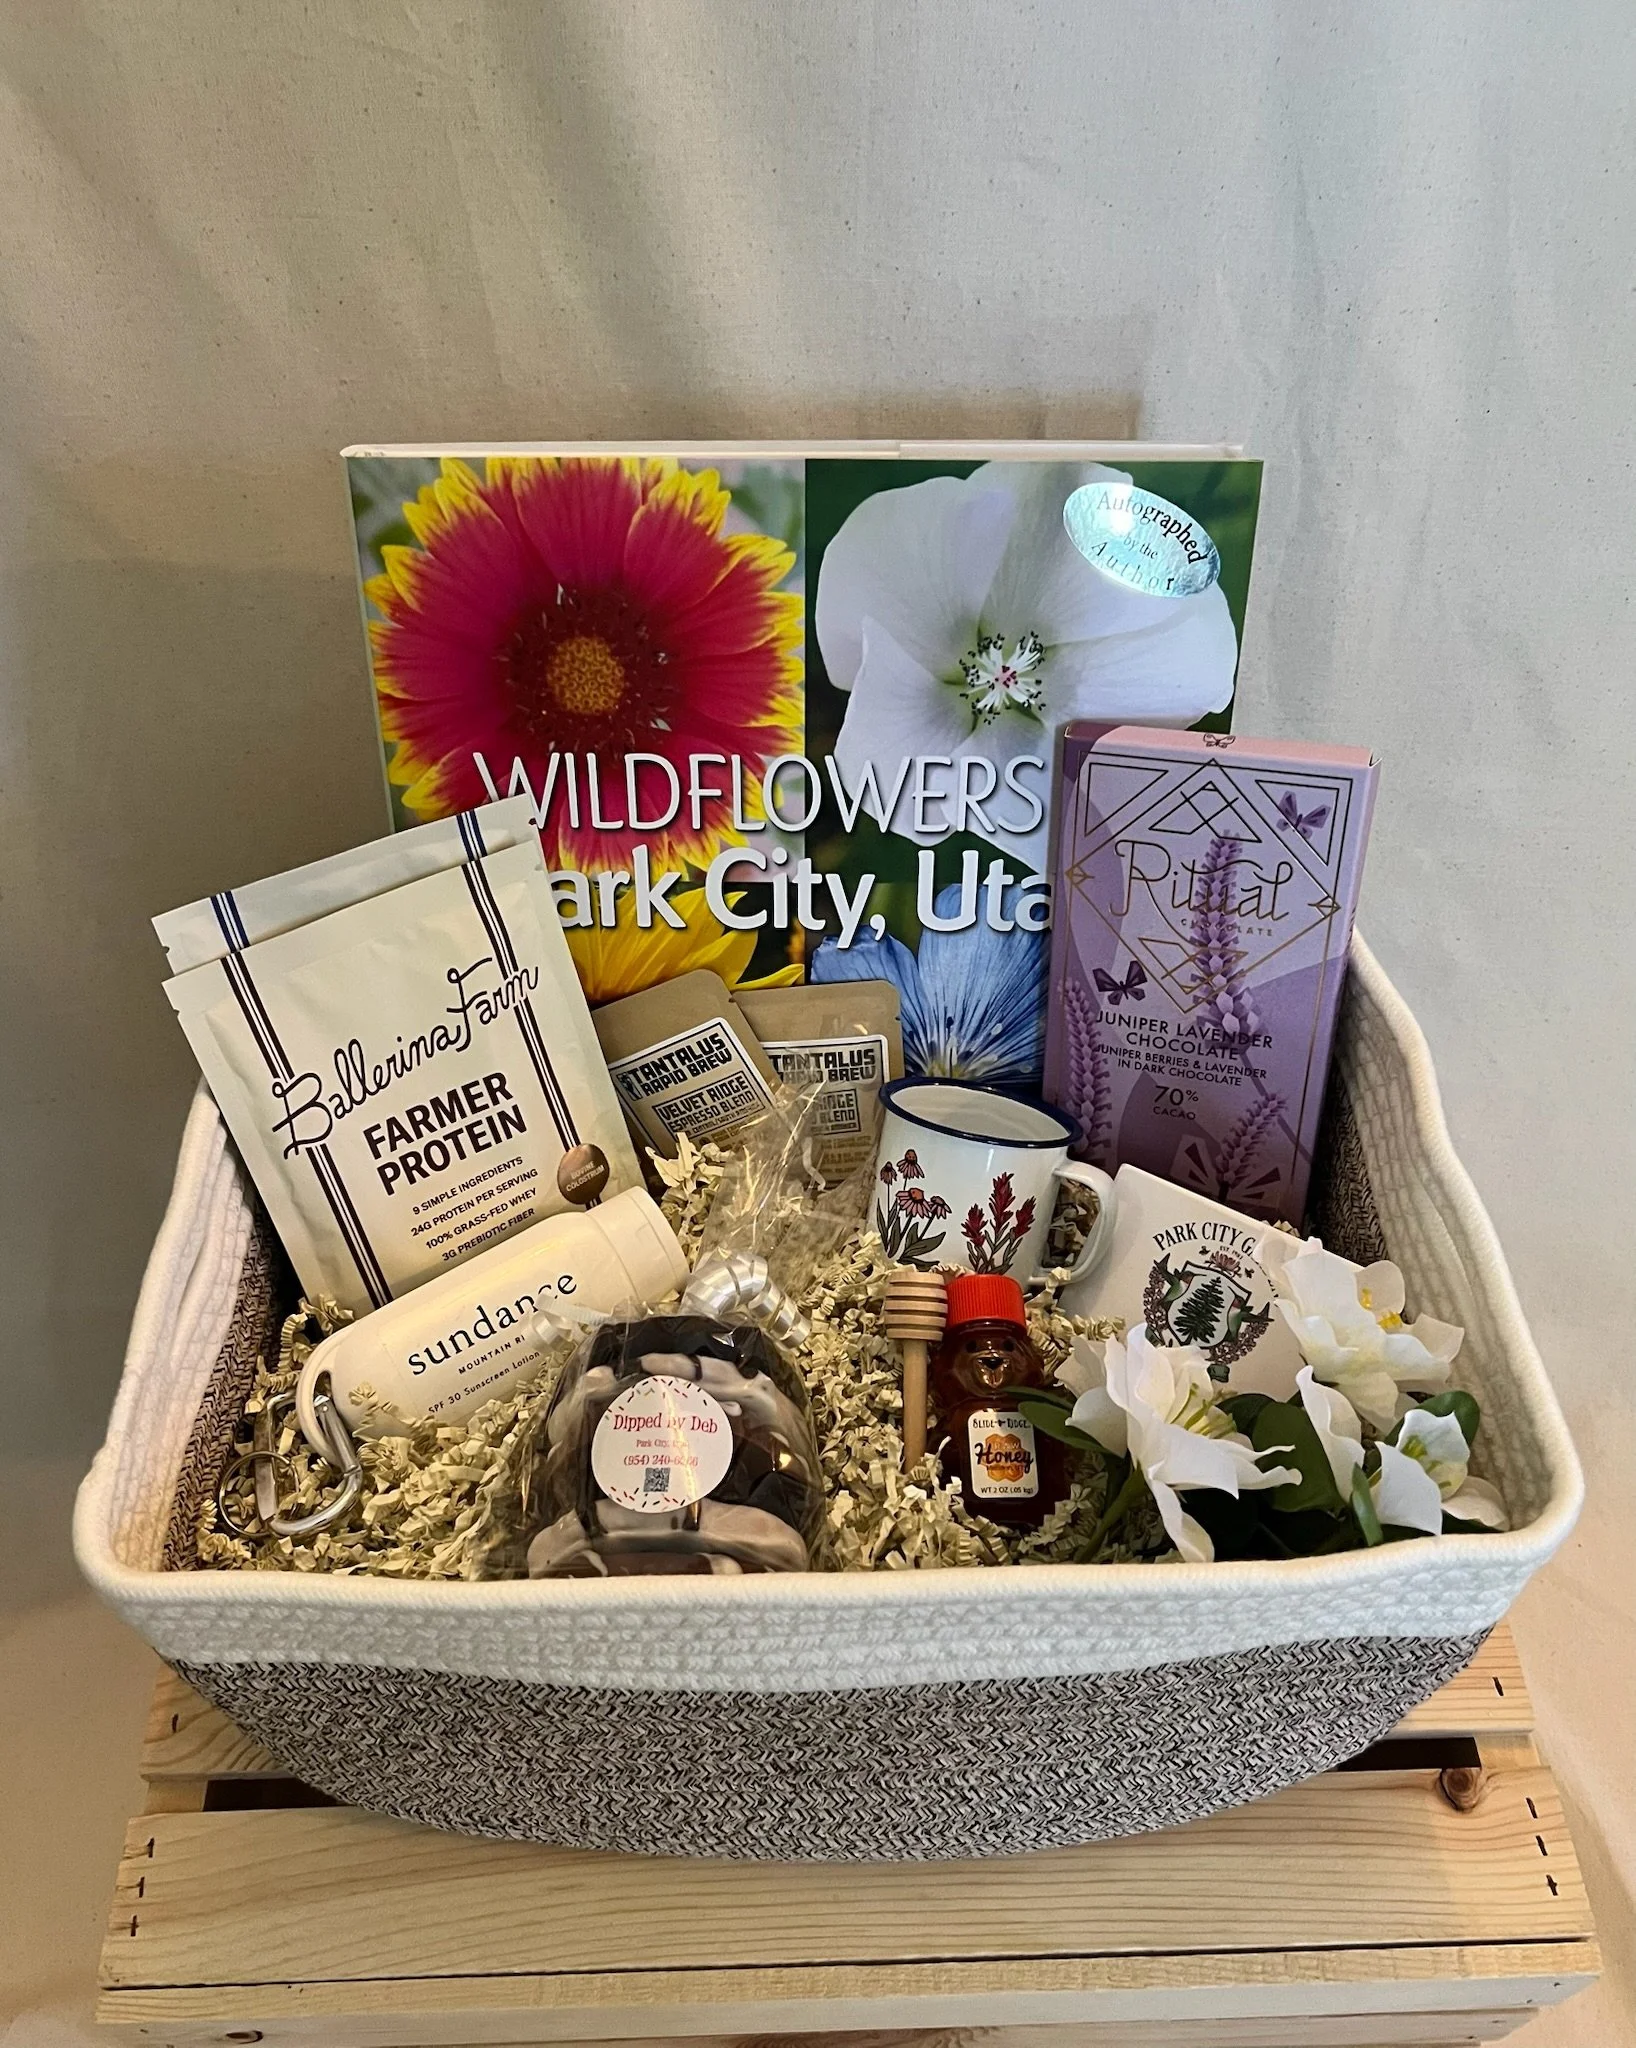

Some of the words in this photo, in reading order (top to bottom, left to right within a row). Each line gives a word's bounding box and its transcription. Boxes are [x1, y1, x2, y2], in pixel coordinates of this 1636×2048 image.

[1097, 491, 1207, 564] Autographed
[1091, 541, 1175, 591] Author
[1140, 542, 1158, 560] the
[472, 752, 1046, 835] WILDFLOWERS
[552, 844, 688, 930] ark
[704, 847, 887, 950] City,
[915, 850, 1052, 933] Uta
[1110, 839, 1293, 944] Ritual
[1096, 1010, 1169, 1035] JUNIPER
[1176, 1023, 1273, 1049] LAVENDER
[1126, 1032, 1240, 1060] CHOCOLATE
[271, 1024, 461, 1160] Ballerina
[446, 957, 539, 1053] Farm
[627, 1033, 727, 1084] TANTALUS
[640, 1070, 688, 1097] RAPID
[687, 1048, 732, 1078] BREW
[768, 1048, 876, 1075] TANTALUS
[828, 1066, 876, 1082] BREW
[1097, 1044, 1142, 1060] JUNIPER
[1145, 1051, 1189, 1068] BERRIES
[1193, 1060, 1201, 1069] &
[1205, 1062, 1267, 1079] LAVENDER
[1118, 1058, 1131, 1069] IN
[1134, 1061, 1166, 1075] DARK
[1169, 1068, 1242, 1087] CHOCOLATE
[363, 1072, 514, 1160] FARMER
[658, 1091, 709, 1121] VELVET
[706, 1075, 749, 1101] RIDGE
[667, 1107, 721, 1132] ESPRESSO
[719, 1090, 755, 1113] BLEND
[1153, 1106, 1196, 1121] CACAO
[1154, 1085, 1199, 1106] 70%
[376, 1104, 528, 1196] PROTEIN
[413, 1206, 421, 1216] 9
[421, 1189, 458, 1212] SIMPLE
[458, 1156, 524, 1193] INGREDIENTS
[566, 1164, 605, 1192] COLOSTRUM
[411, 1221, 432, 1237] 24G
[432, 1199, 476, 1226] PROTEIN
[476, 1189, 496, 1205] PER
[496, 1168, 539, 1195] SERVING
[426, 1231, 454, 1249] 100%
[454, 1203, 509, 1235] GRASS-FED
[510, 1188, 538, 1207] WHEY
[442, 1249, 457, 1262] 3G
[457, 1223, 509, 1254] PREBIOTIC
[508, 1207, 535, 1228] FIBER
[1152, 1222, 1198, 1251] PARK
[1202, 1222, 1243, 1246] CITY
[458, 1342, 512, 1375] MOUNTAIN
[428, 1402, 445, 1413] SPF
[448, 1392, 462, 1404] 30
[464, 1366, 511, 1396] Sunscreen
[512, 1351, 541, 1369] Lotion
[613, 1412, 662, 1432] Dipped
[690, 1415, 718, 1434] Deb
[974, 1442, 1034, 1474] Honey
